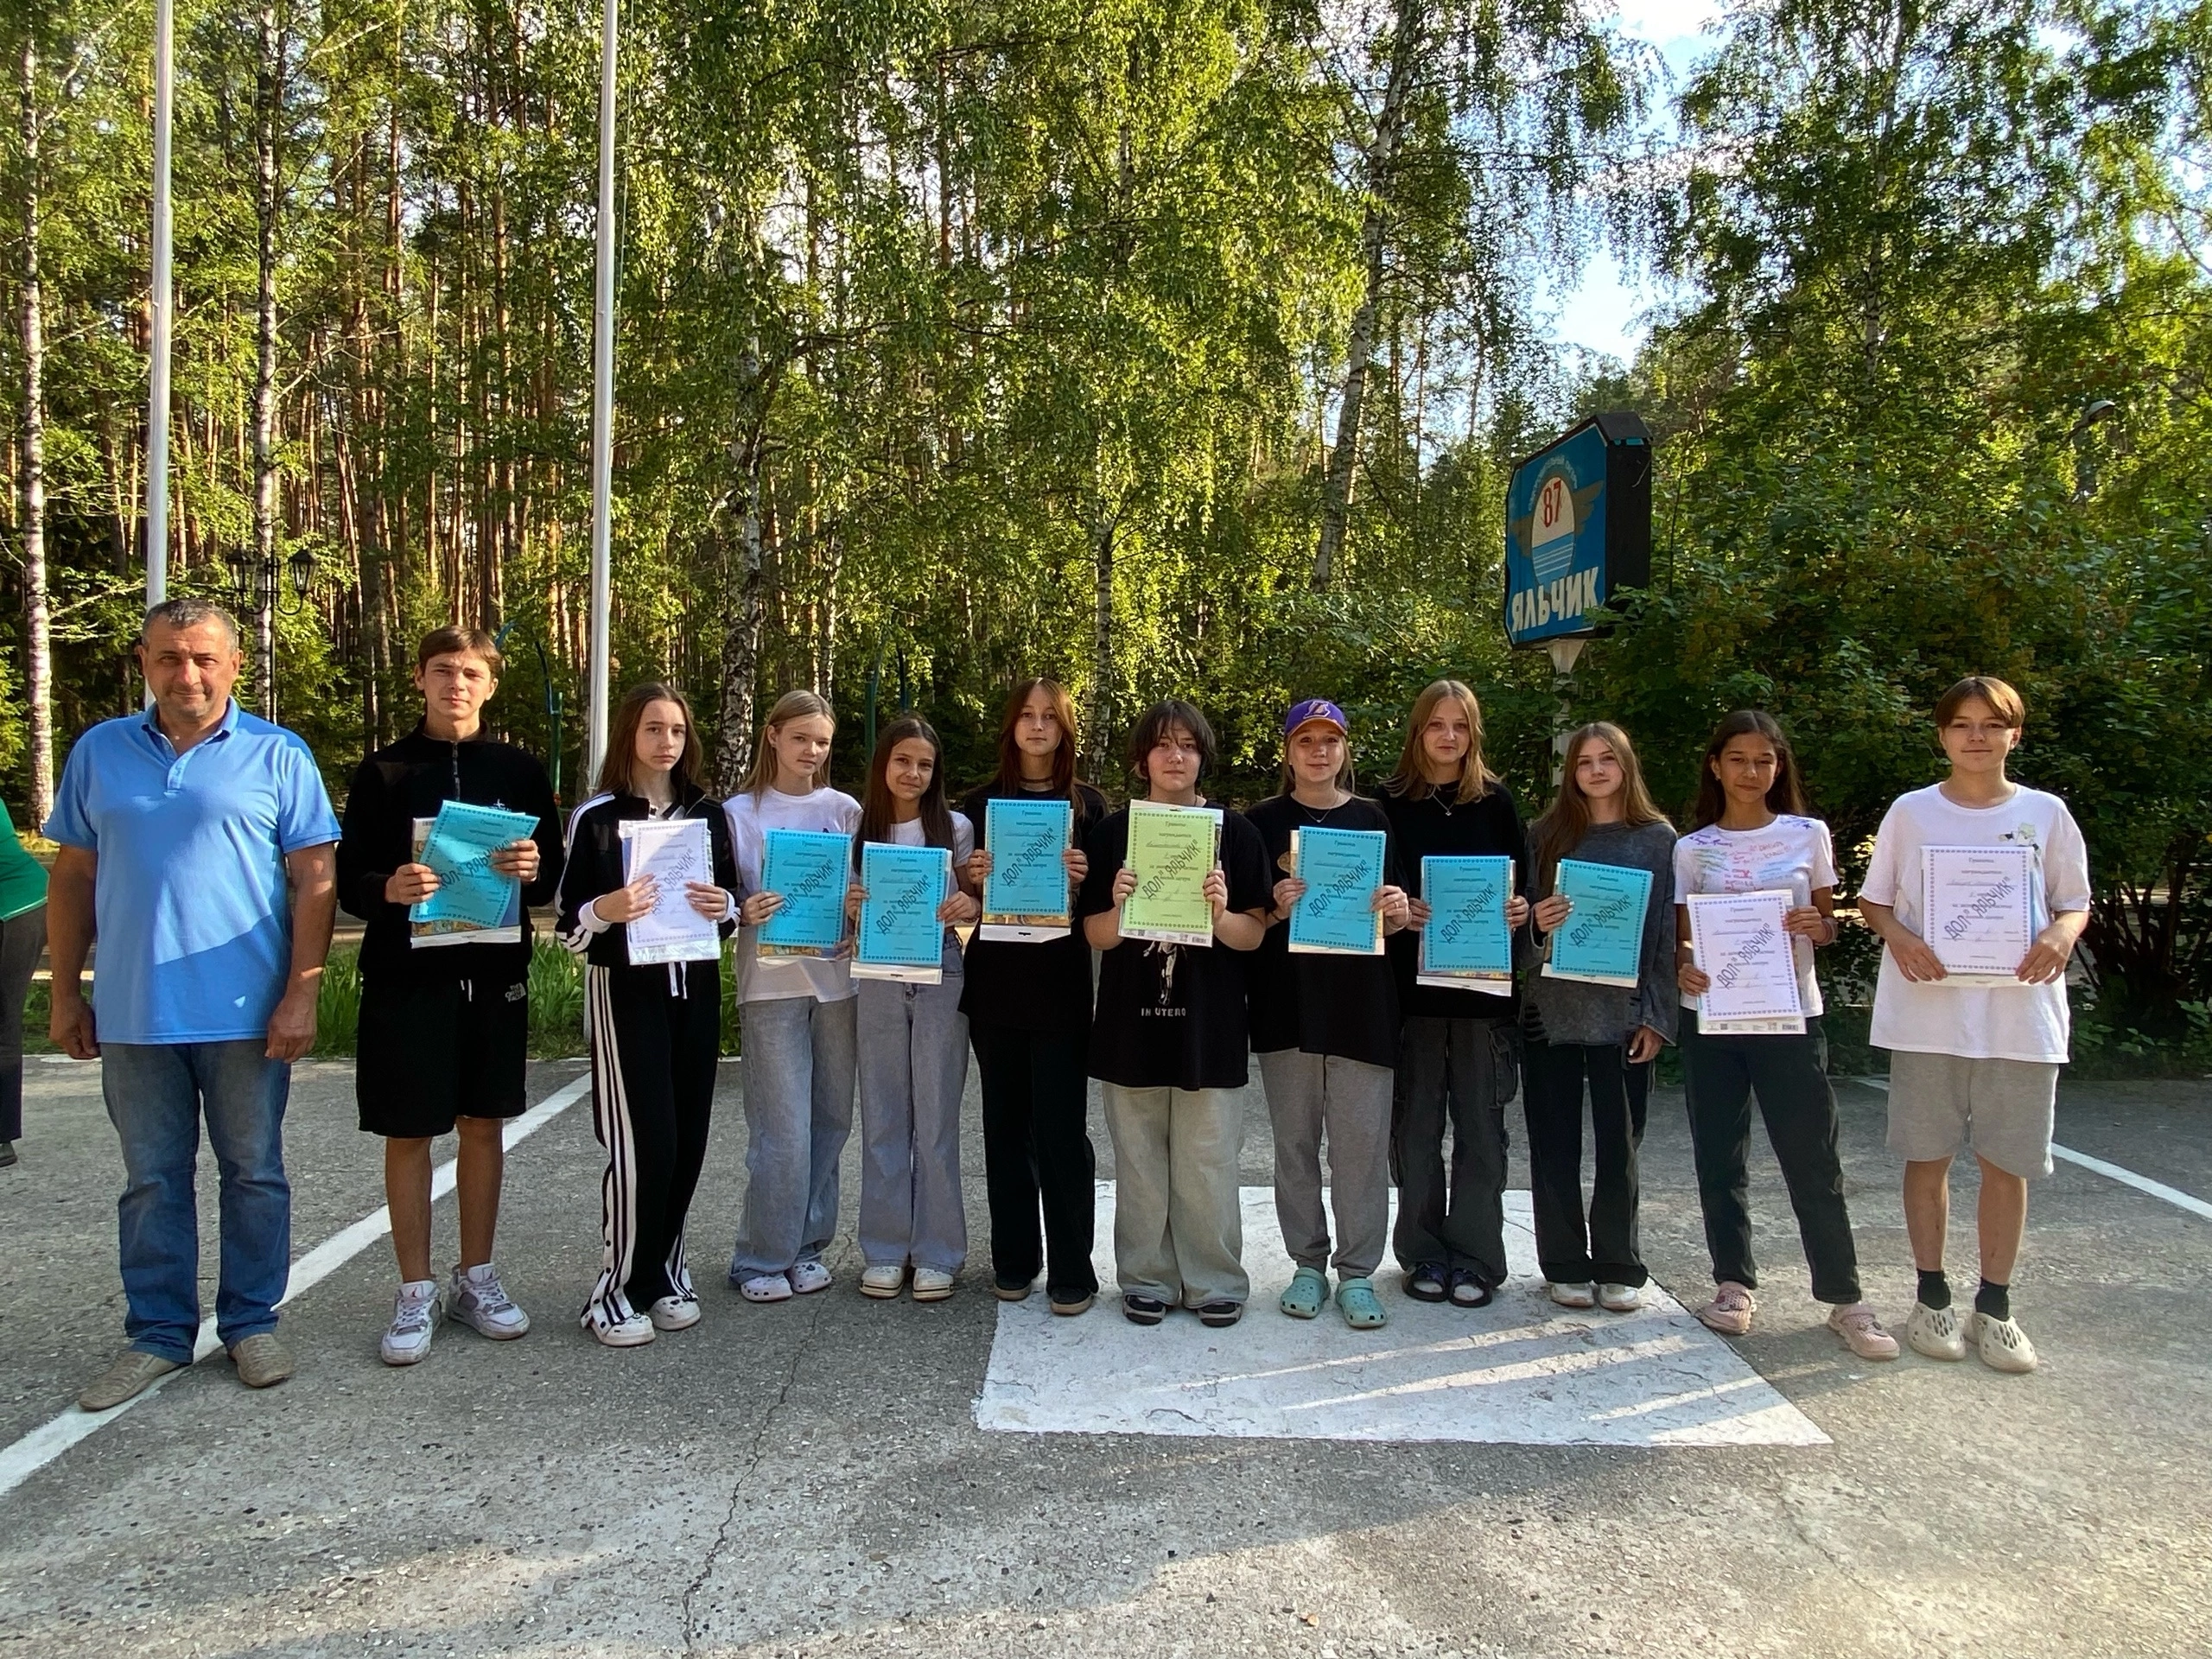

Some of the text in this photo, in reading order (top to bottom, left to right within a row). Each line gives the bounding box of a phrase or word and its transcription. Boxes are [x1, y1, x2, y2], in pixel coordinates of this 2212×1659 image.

[1543, 480, 1562, 528] 87
[1512, 566, 1599, 632] ЯЛЬЧИК
[1001, 862, 1023, 887] ДОЛ
[1141, 875, 1165, 901] ДОЛ
[1308, 893, 1331, 918] ДОЛ
[876, 910, 898, 935] ДОЛ
[1440, 918, 1463, 944] ДОЛ
[1570, 923, 1593, 948] ДОЛ
[1944, 915, 1972, 942] ДОЛ
[1717, 963, 1740, 990] ДОЛ
[1154, 1007, 1186, 1016] UTERO
